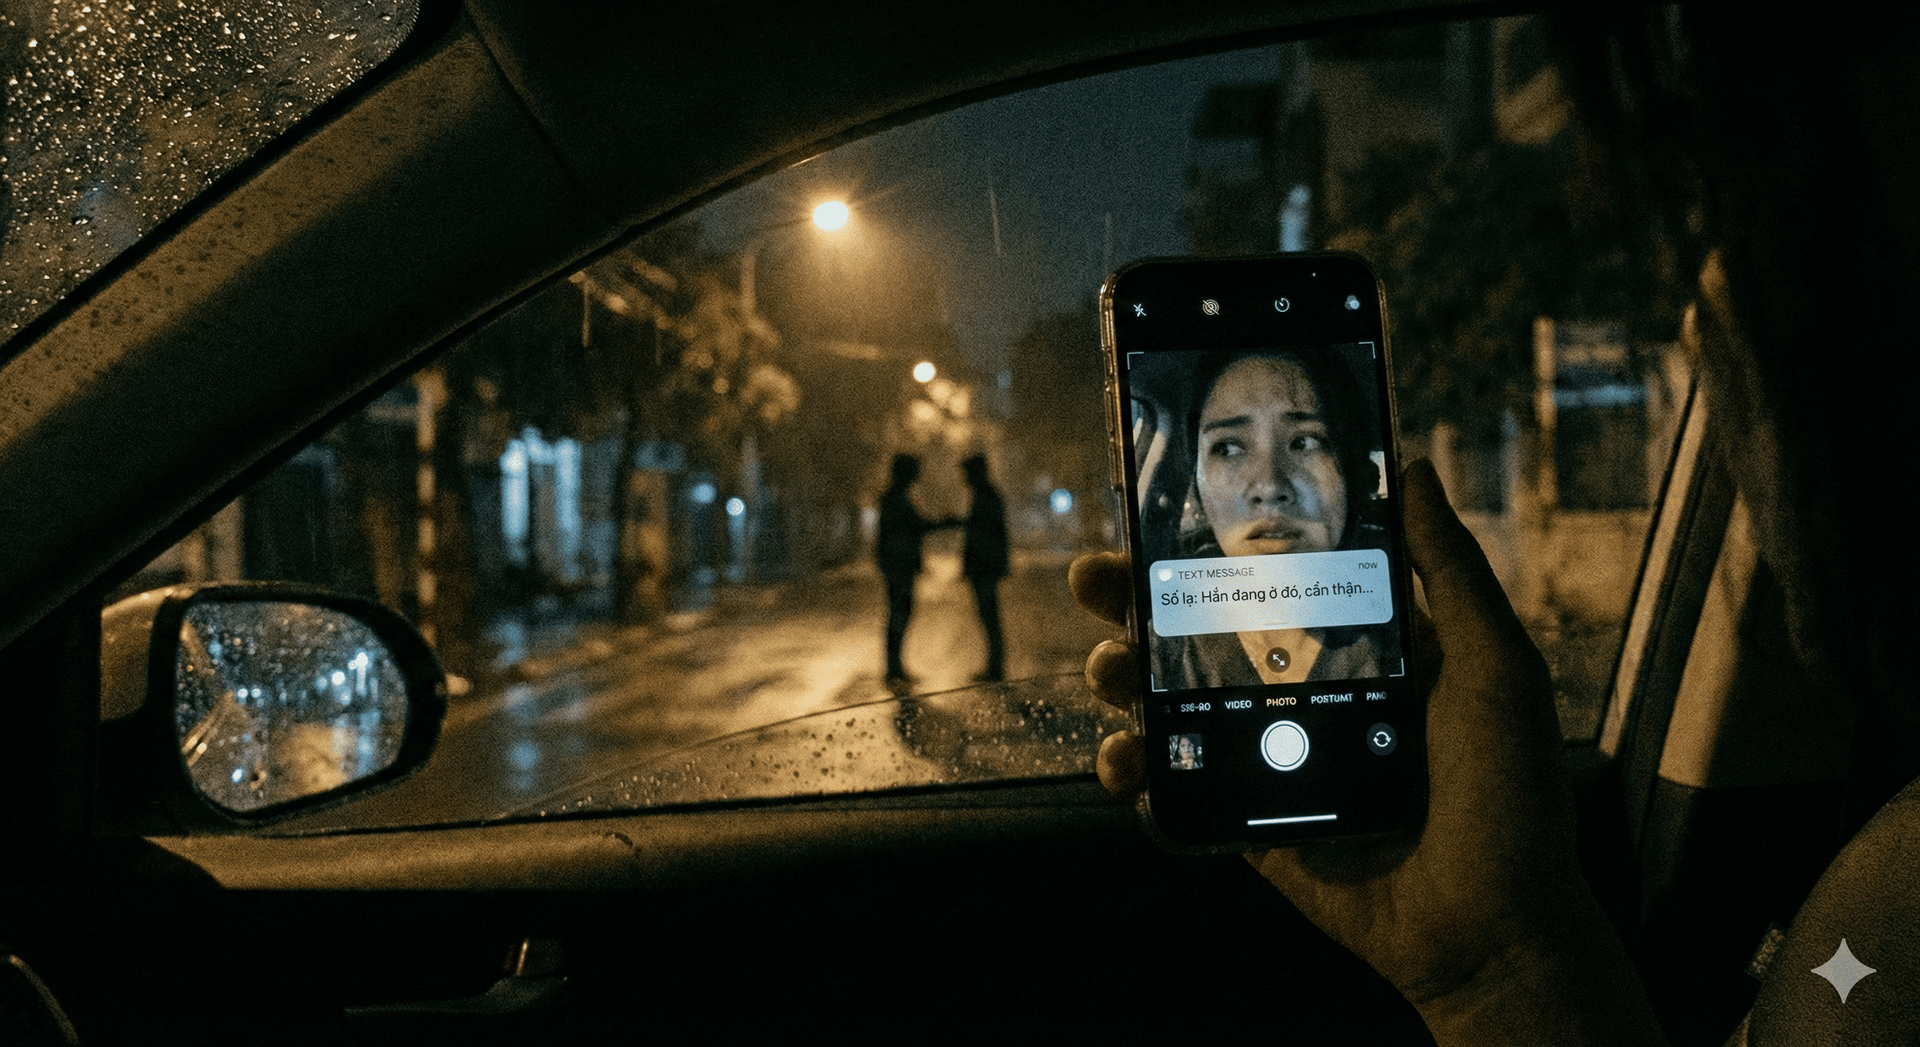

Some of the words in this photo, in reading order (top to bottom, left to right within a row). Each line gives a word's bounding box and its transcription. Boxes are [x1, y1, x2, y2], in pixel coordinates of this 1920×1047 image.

[1358, 562, 1378, 570] now
[1178, 570, 1204, 580] TEXT
[1207, 567, 1255, 578] MESSAGE
[1161, 589, 1179, 606] Số
[1182, 592, 1198, 607] lạ:
[1232, 589, 1266, 603] đang
[1281, 585, 1302, 600] đó,
[1332, 581, 1373, 598] thận...
[1225, 700, 1252, 709] VIDEO
[1266, 697, 1297, 706] PHOTO
